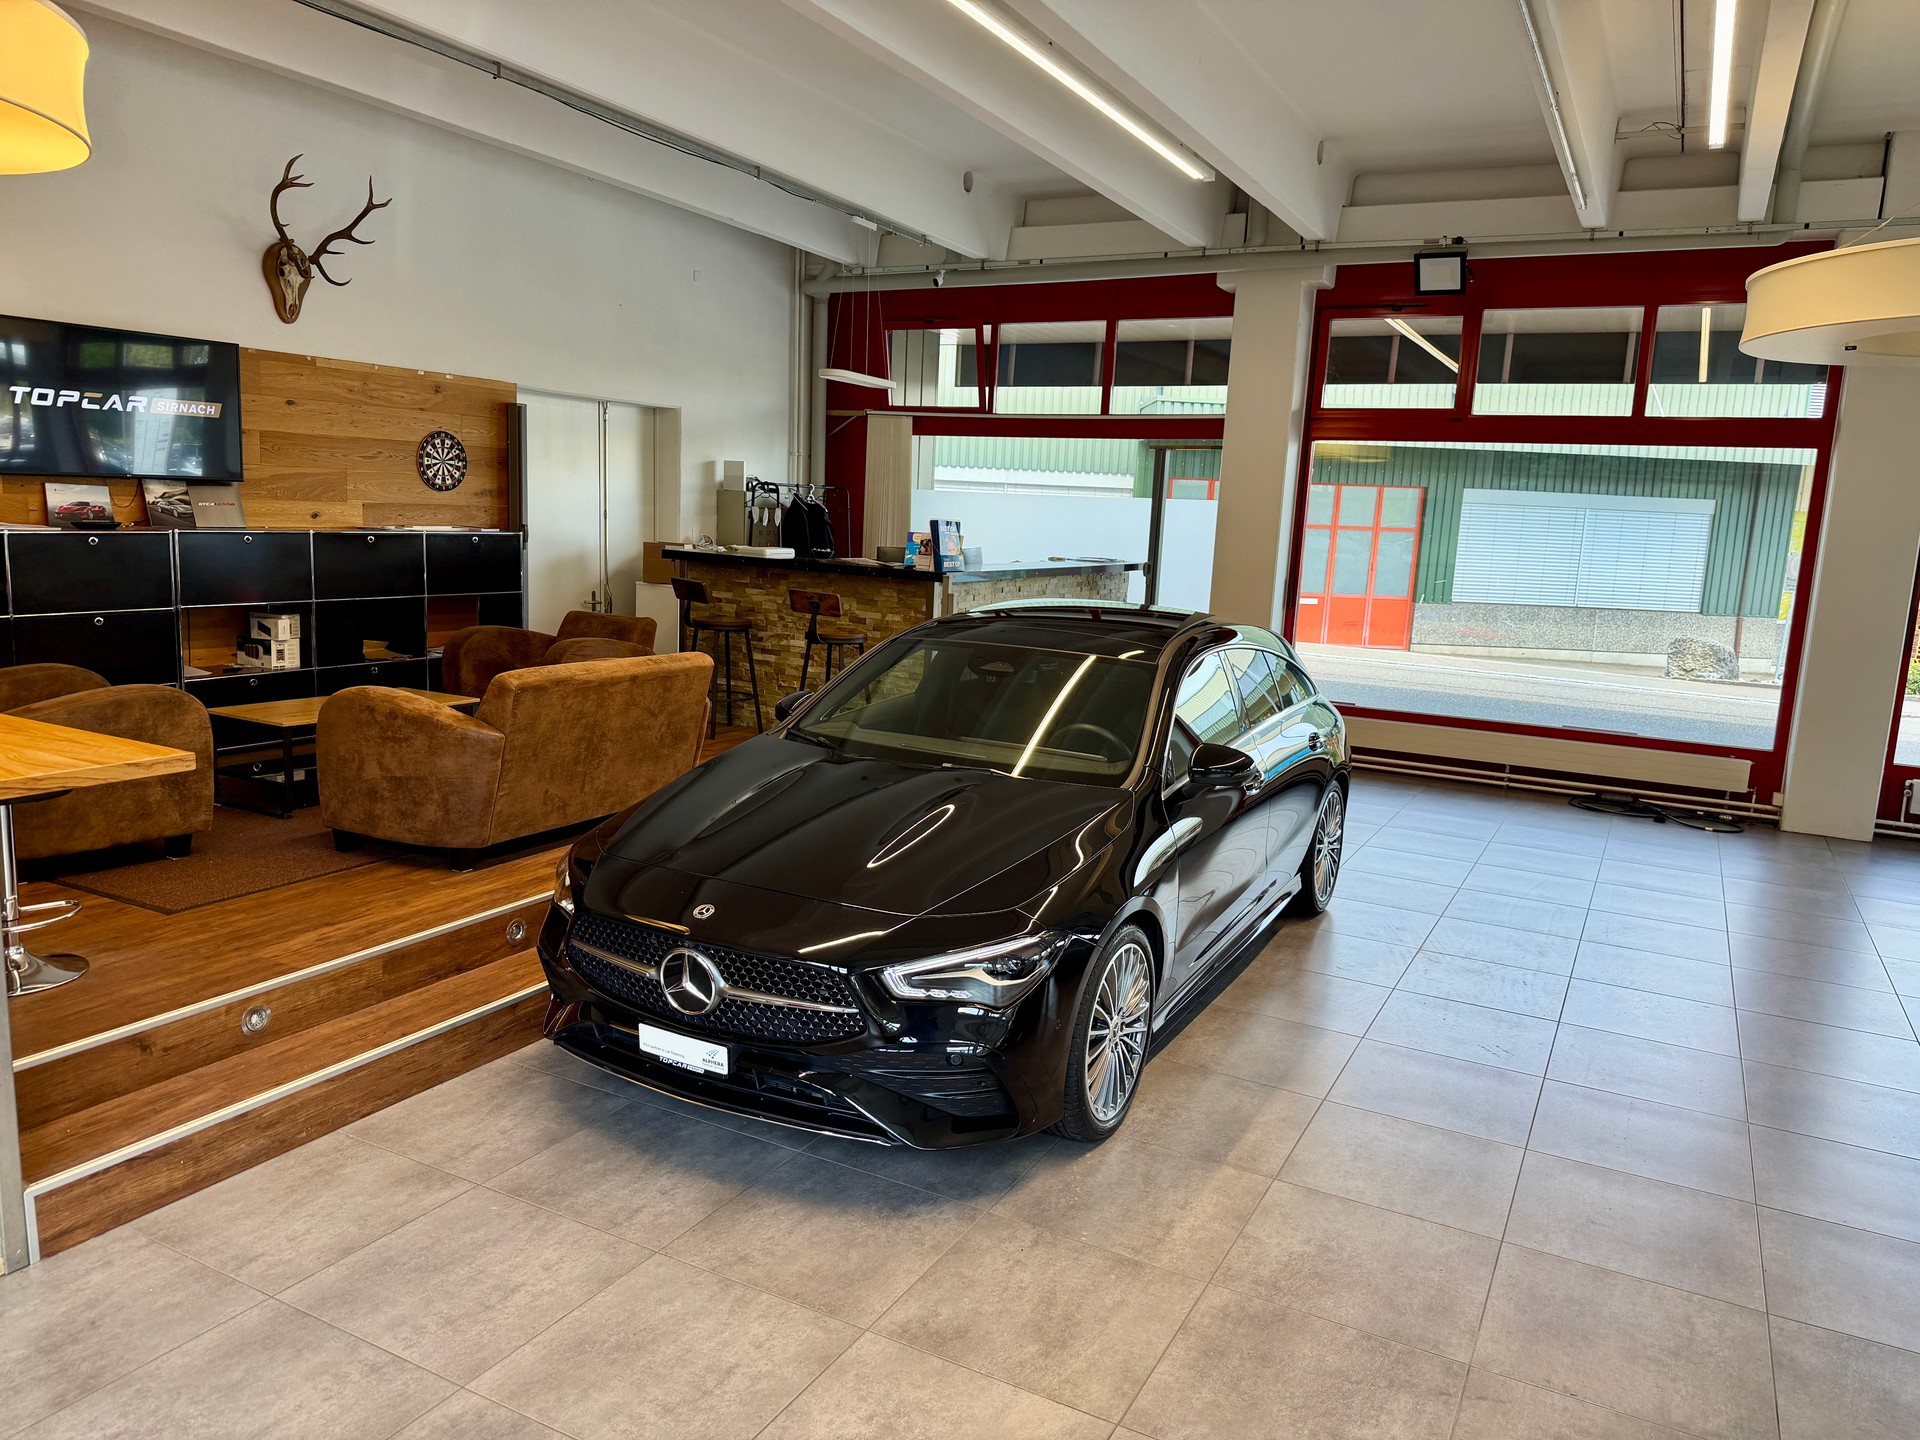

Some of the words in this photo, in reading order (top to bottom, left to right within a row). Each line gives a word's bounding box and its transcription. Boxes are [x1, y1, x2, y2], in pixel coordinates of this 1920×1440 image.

[9, 386, 148, 413] TOPCAR
[156, 401, 216, 415] SIRNACH
[659, 1056, 687, 1069] TOPCAR
[702, 1057, 724, 1067] ALPHERA
